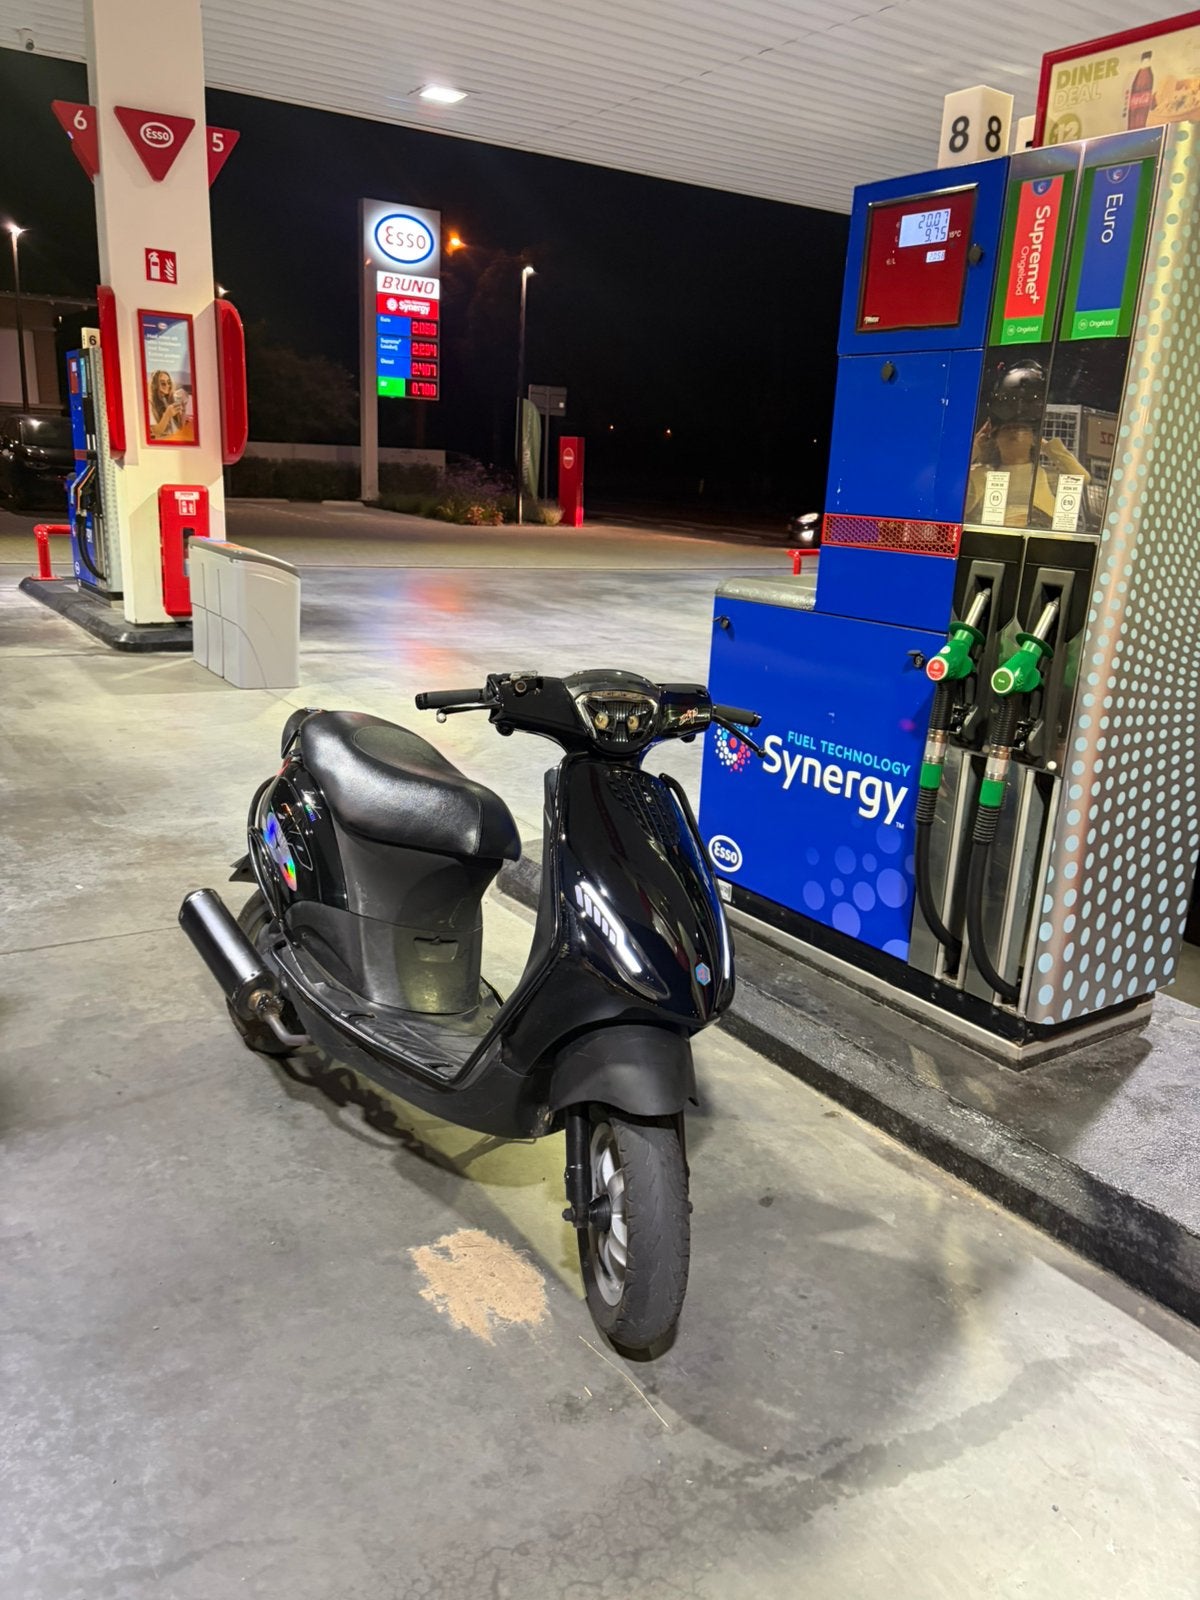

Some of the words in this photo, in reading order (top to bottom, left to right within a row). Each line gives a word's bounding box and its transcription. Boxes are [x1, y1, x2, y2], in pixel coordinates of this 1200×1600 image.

[1056, 57, 1120, 90] DINER
[1054, 82, 1102, 109] DEAL
[74, 109, 88, 130] 6
[212, 132, 225, 152] 5
[949, 115, 970, 153] 8
[985, 115, 1002, 153] 8
[919, 211, 949, 229] 20.07
[1101, 193, 1123, 243] Euro
[386, 226, 426, 249] Esso
[925, 227, 947, 243] 9.75
[1015, 246, 1030, 296] Ongelood
[383, 276, 436, 295] BRUNO
[399, 301, 430, 315] Synergy
[89, 334, 97, 346] 6
[1063, 498, 1073, 506] E10
[787, 730, 817, 750] FUEL
[821, 739, 911, 777] TECHNOLOGY
[762, 734, 909, 825] Synergy
[714, 841, 738, 864] Esso
